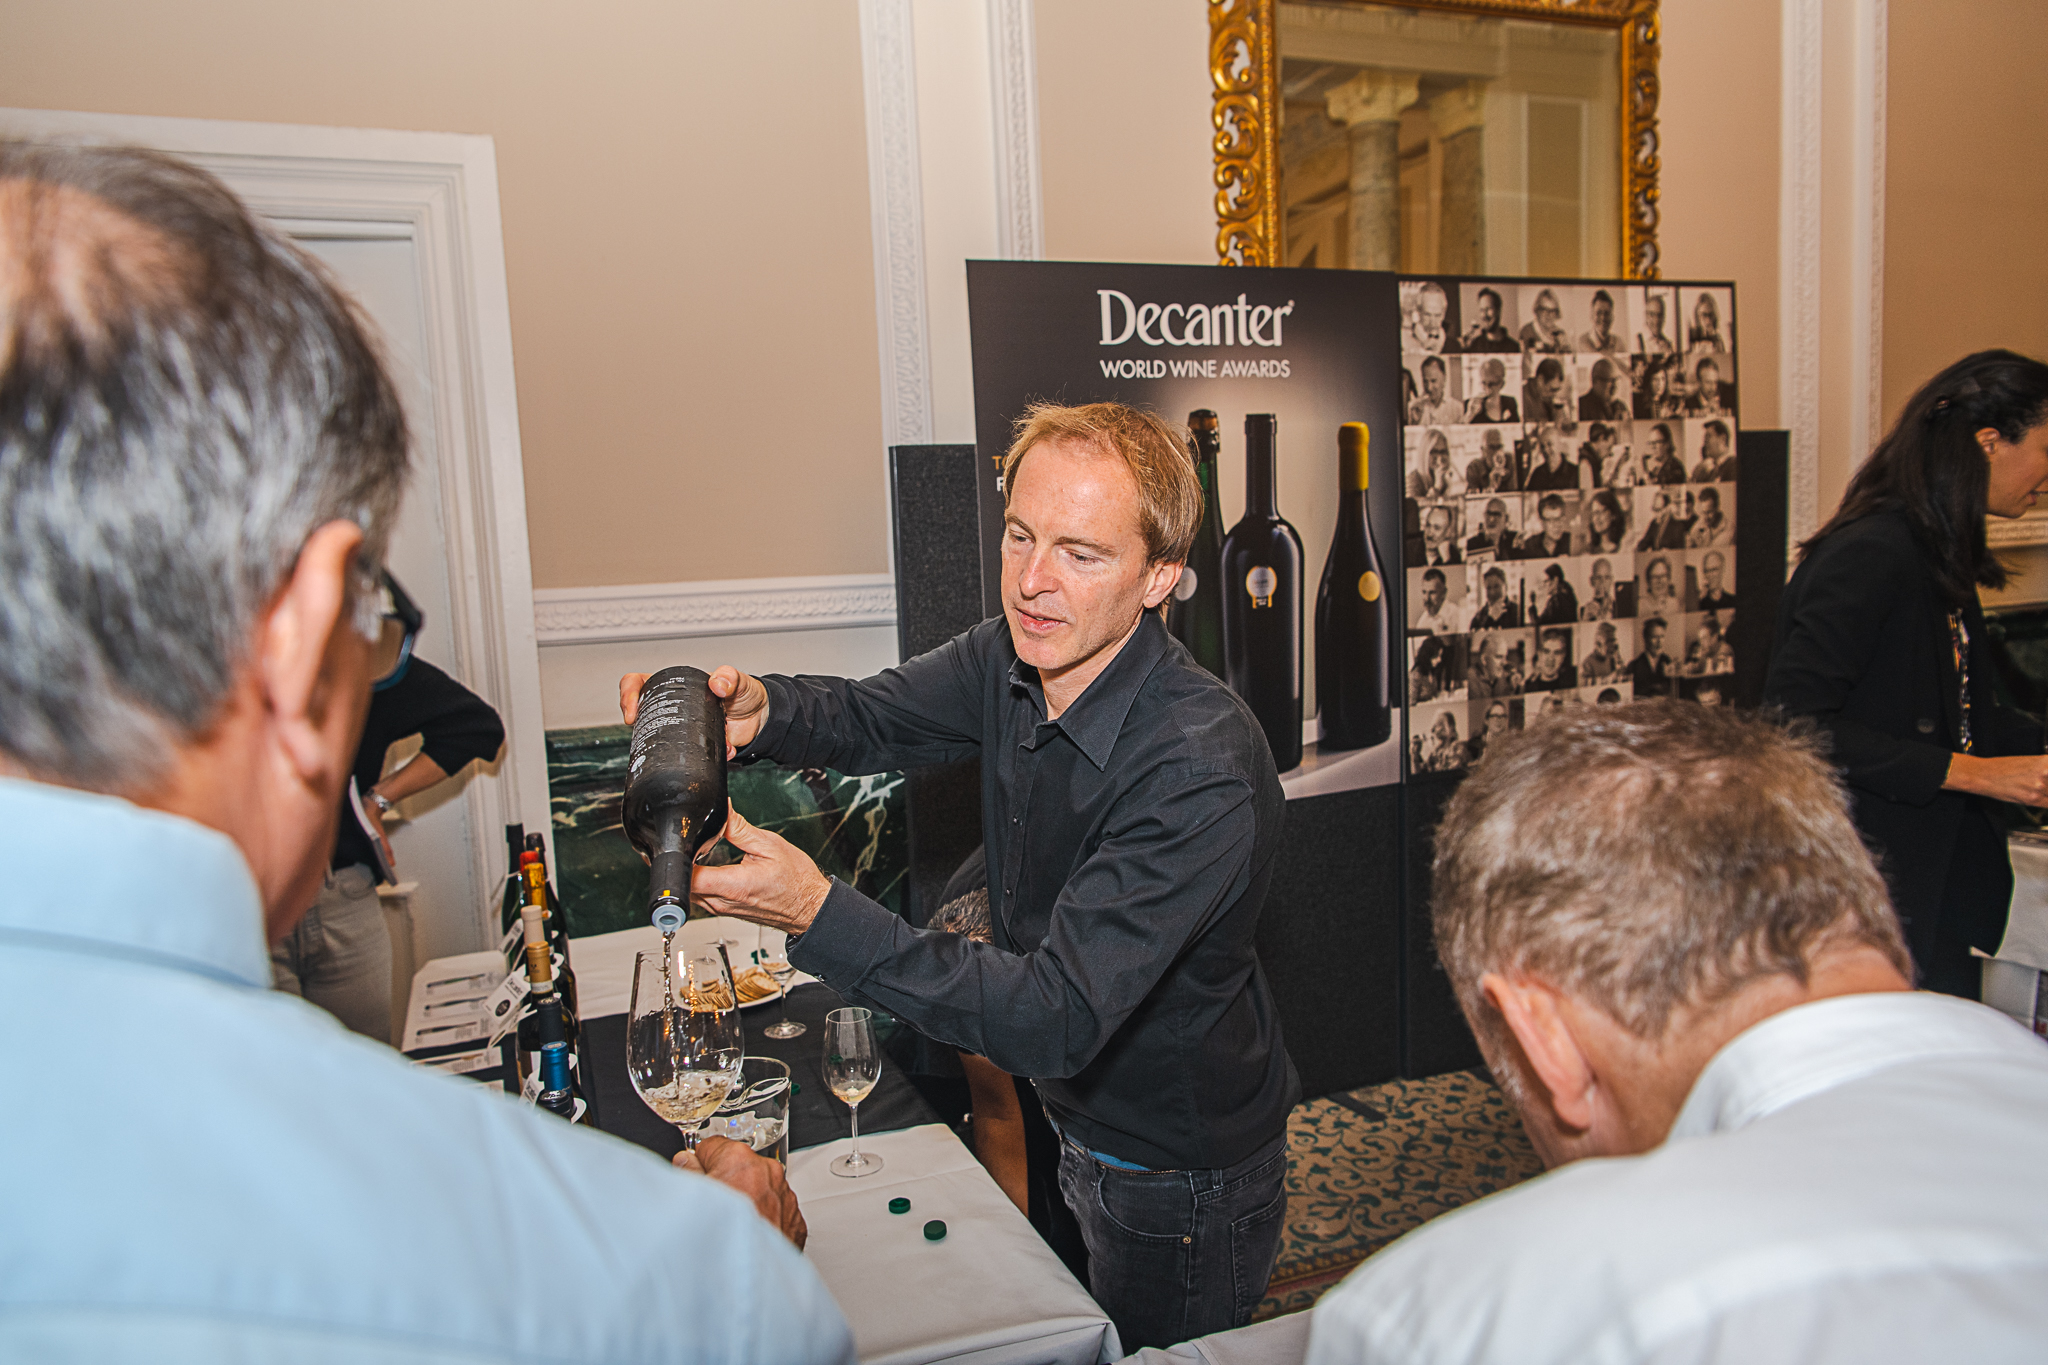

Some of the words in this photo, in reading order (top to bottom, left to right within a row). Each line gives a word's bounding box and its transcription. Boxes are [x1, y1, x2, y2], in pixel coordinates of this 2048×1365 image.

[1097, 289, 1294, 347] Decanter
[1100, 359, 1167, 379] WORLD
[1169, 359, 1217, 378] WINE
[1220, 359, 1291, 378] AWARDS
